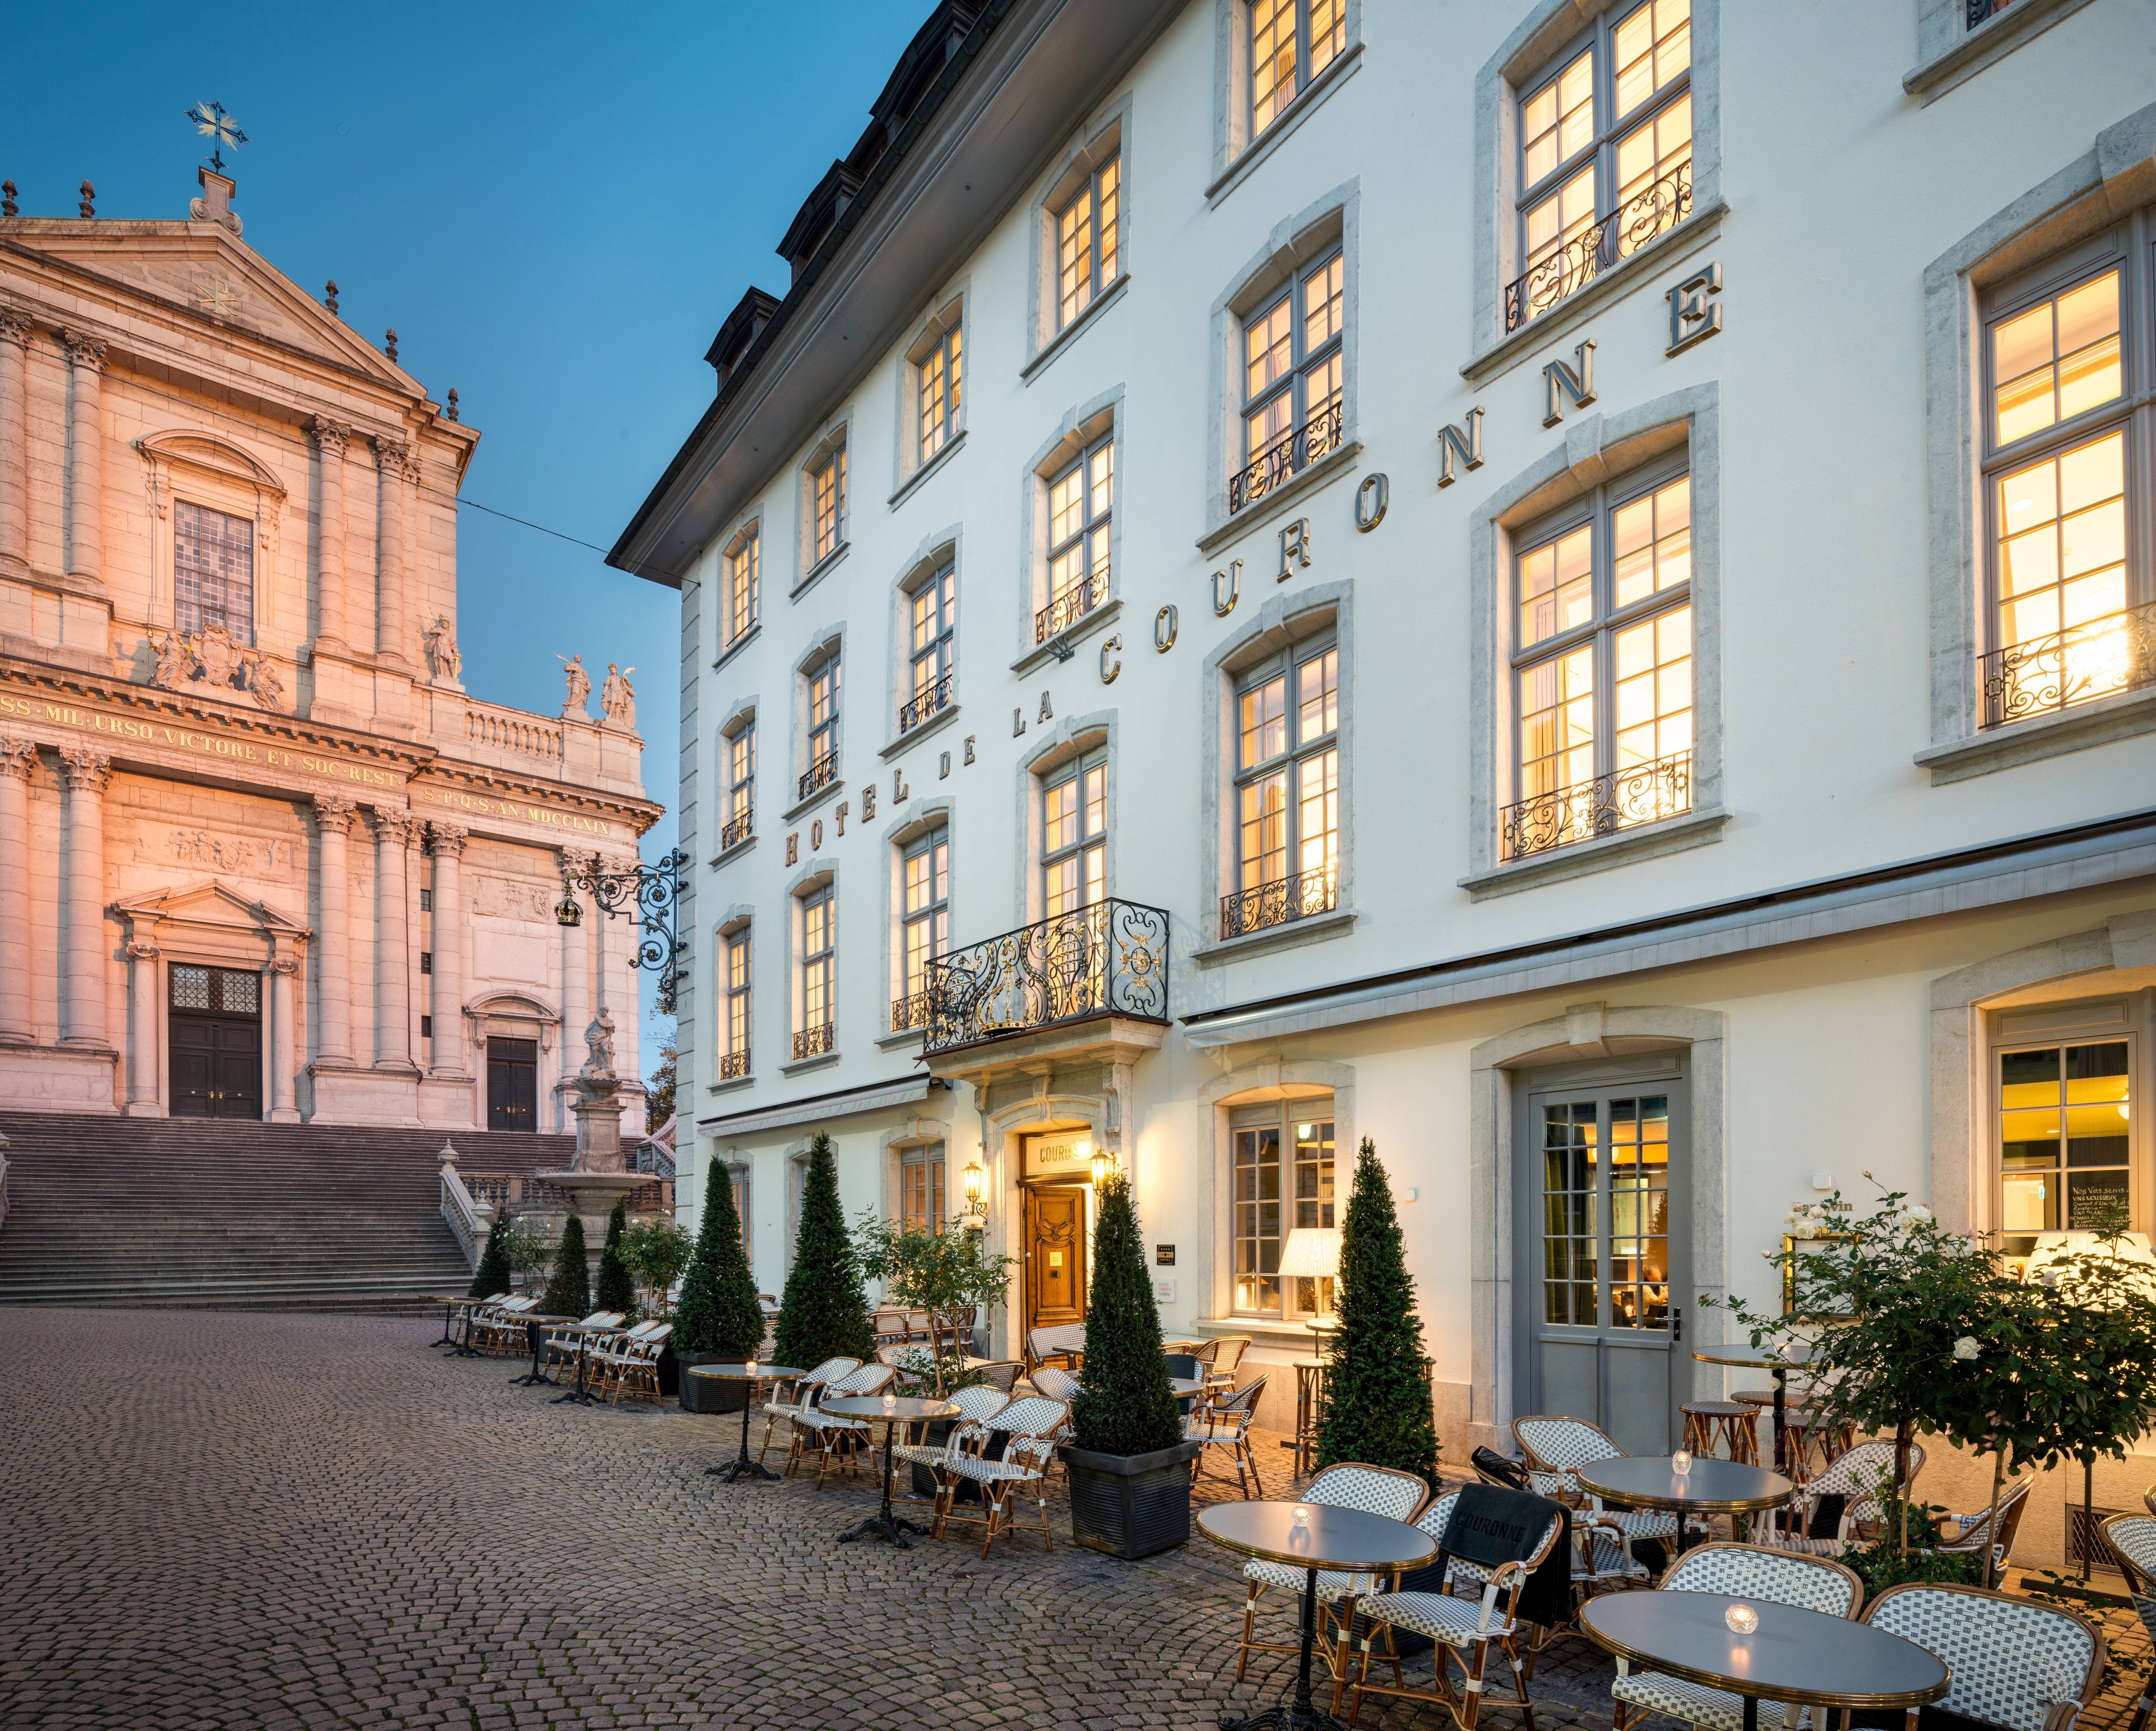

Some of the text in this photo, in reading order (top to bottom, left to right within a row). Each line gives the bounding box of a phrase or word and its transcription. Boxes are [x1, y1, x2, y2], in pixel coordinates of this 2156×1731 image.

[785, 262, 1722, 867] HOTEL DE LA COURONNE
[163, 729, 257, 760] VICTORE
[267, 750, 293, 767] ET
[1831, 1201, 1853, 1211] vin
[1455, 1511, 1526, 1543] COURONNE
